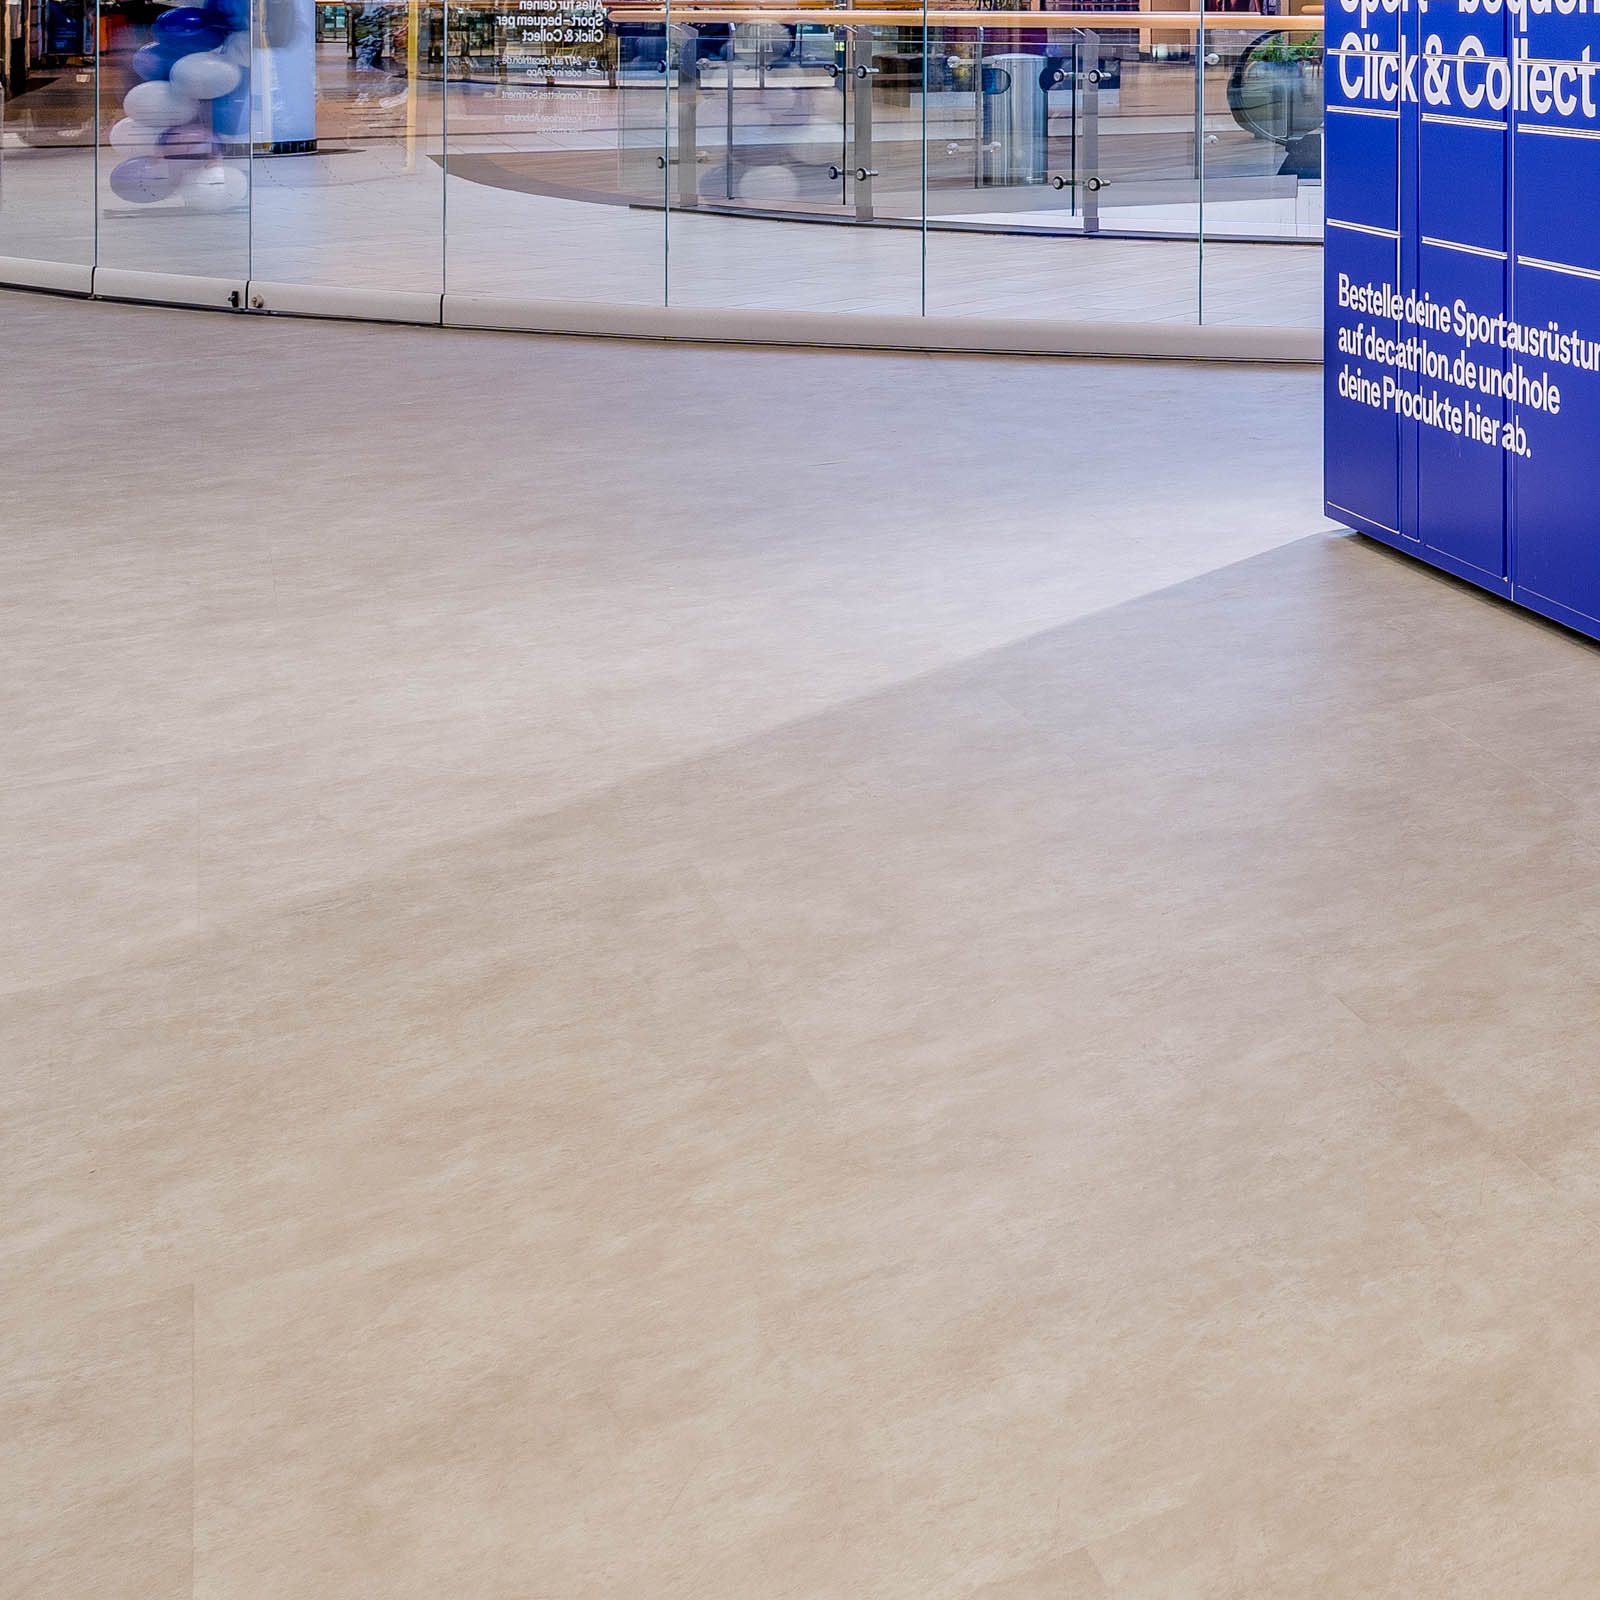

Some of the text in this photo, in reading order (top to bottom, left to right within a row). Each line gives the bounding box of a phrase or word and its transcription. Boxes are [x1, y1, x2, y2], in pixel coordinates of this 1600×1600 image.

[1339, 32, 1597, 118] Click & Collect
[1338, 272, 1404, 321] Bestelle
[1405, 289, 1451, 333] deine
[1338, 323, 1364, 354] auf
[1365, 326, 1477, 390] decathlon.de
[1338, 364, 1532, 458] deine Produkte hier ab.
